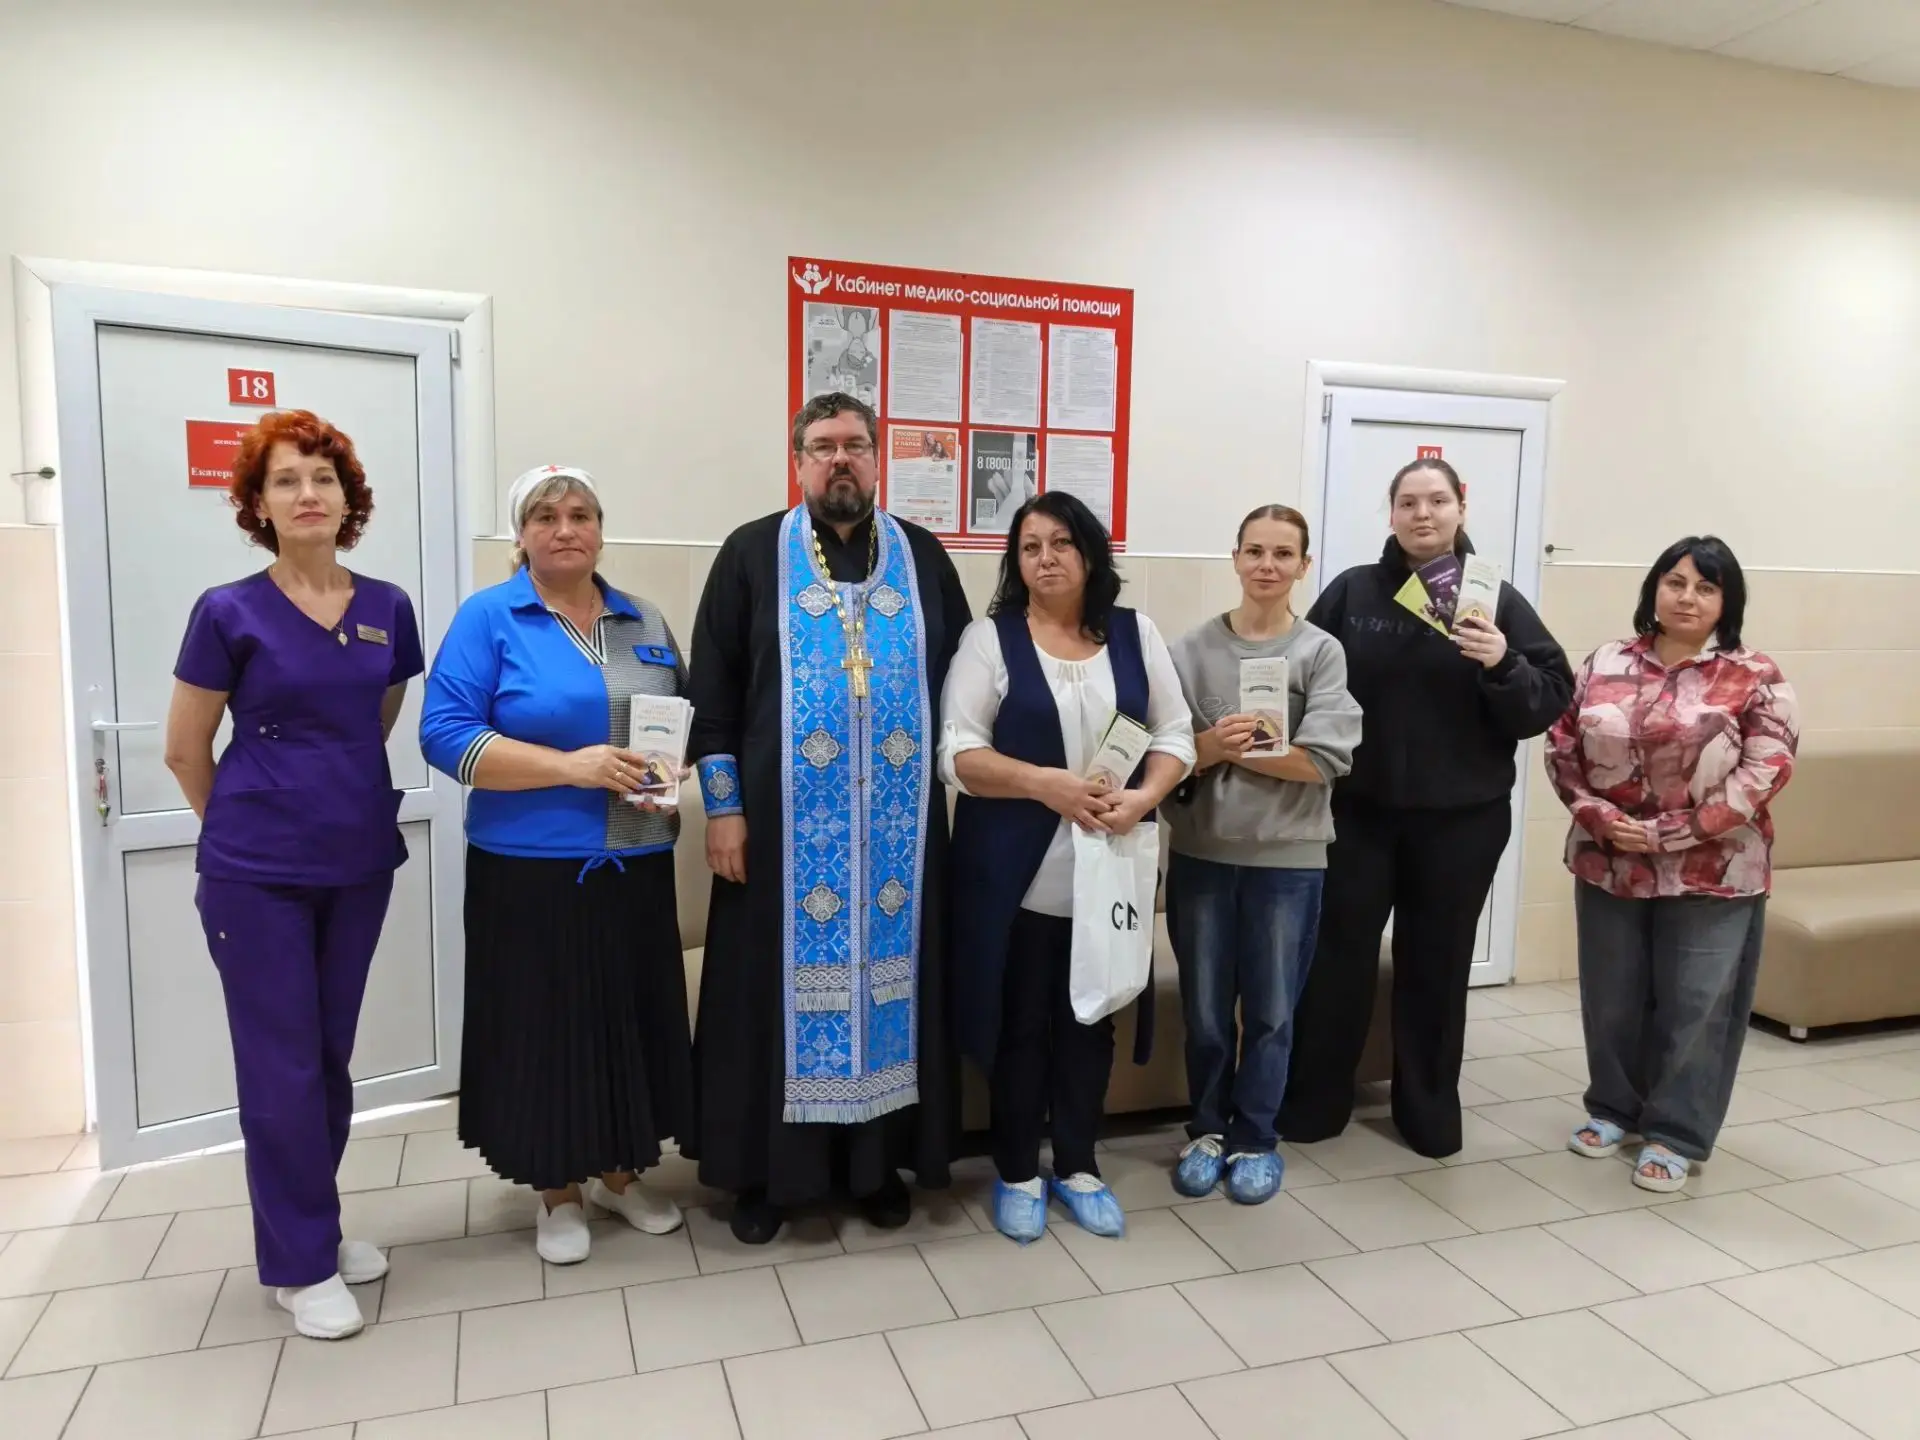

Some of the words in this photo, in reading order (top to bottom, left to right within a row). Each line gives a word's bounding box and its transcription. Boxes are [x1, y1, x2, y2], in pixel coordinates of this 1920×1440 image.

[835, 273, 902, 297] Кабинет
[904, 283, 1060, 311] медико-социальной
[1062, 298, 1121, 318] помощи
[237, 375, 269, 399] 18
[977, 456, 984, 469] 8
[985, 456, 1011, 470] (800)
